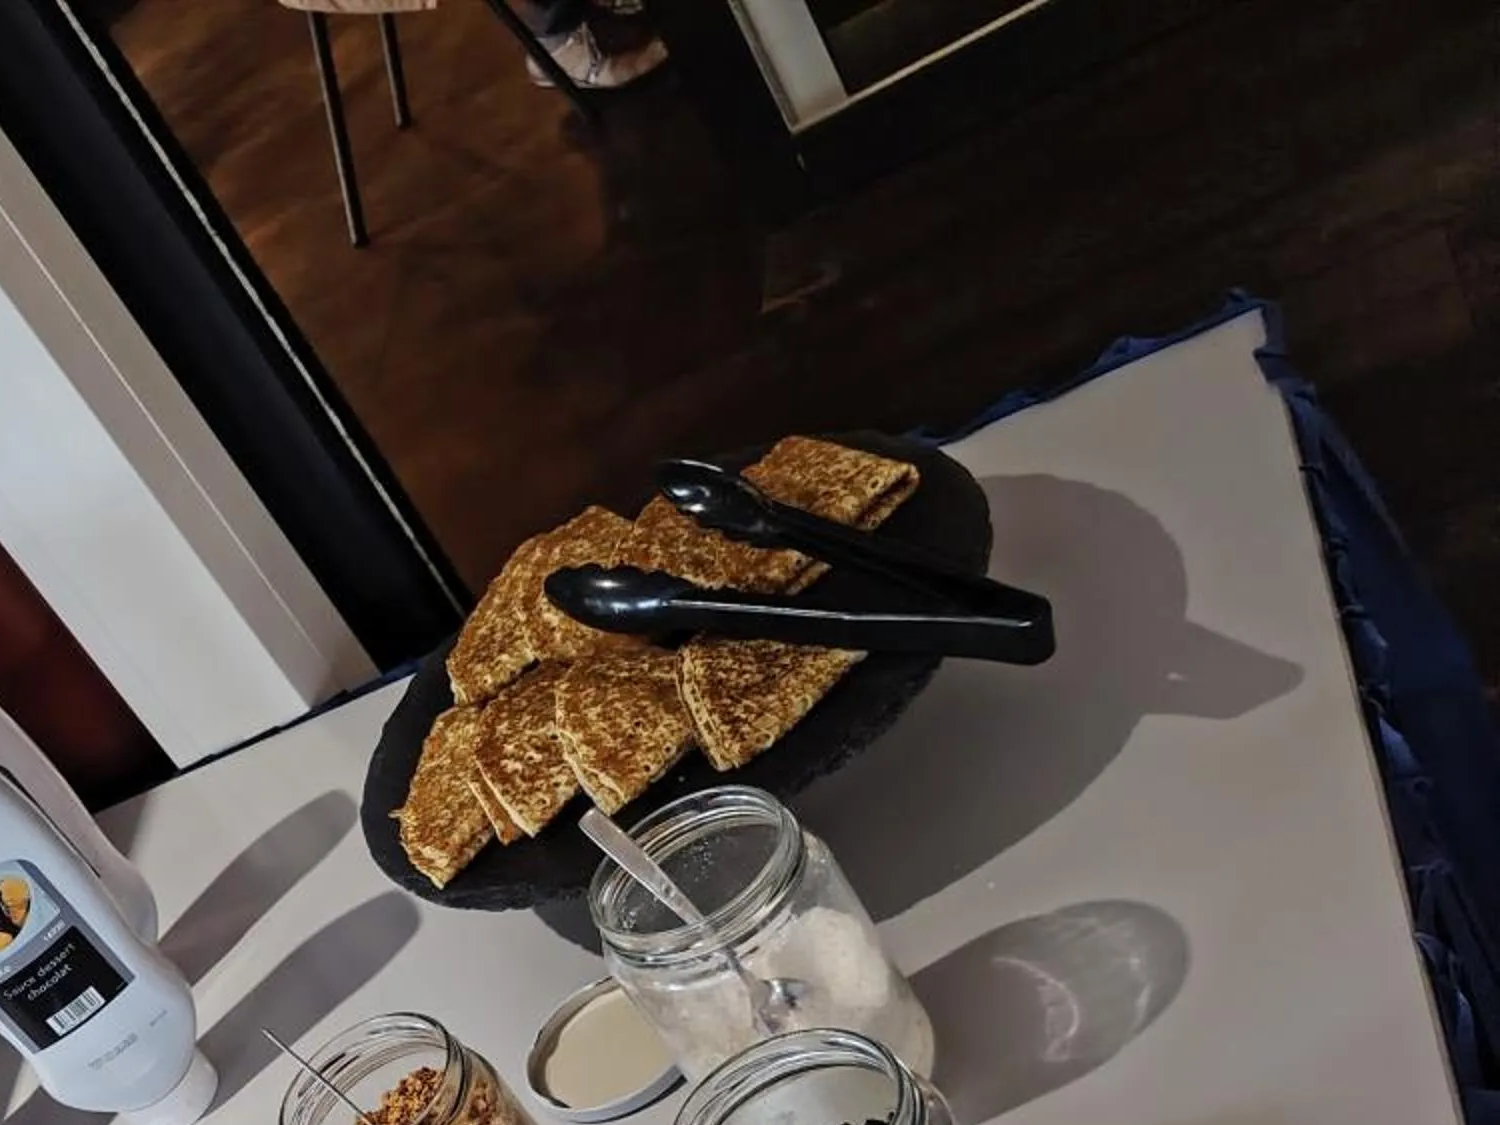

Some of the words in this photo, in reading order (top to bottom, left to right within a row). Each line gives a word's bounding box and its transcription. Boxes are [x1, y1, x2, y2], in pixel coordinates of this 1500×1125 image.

[3, 975, 37, 1001] Sauce
[37, 942, 77, 978] dessert
[27, 963, 74, 1001] chocolat
